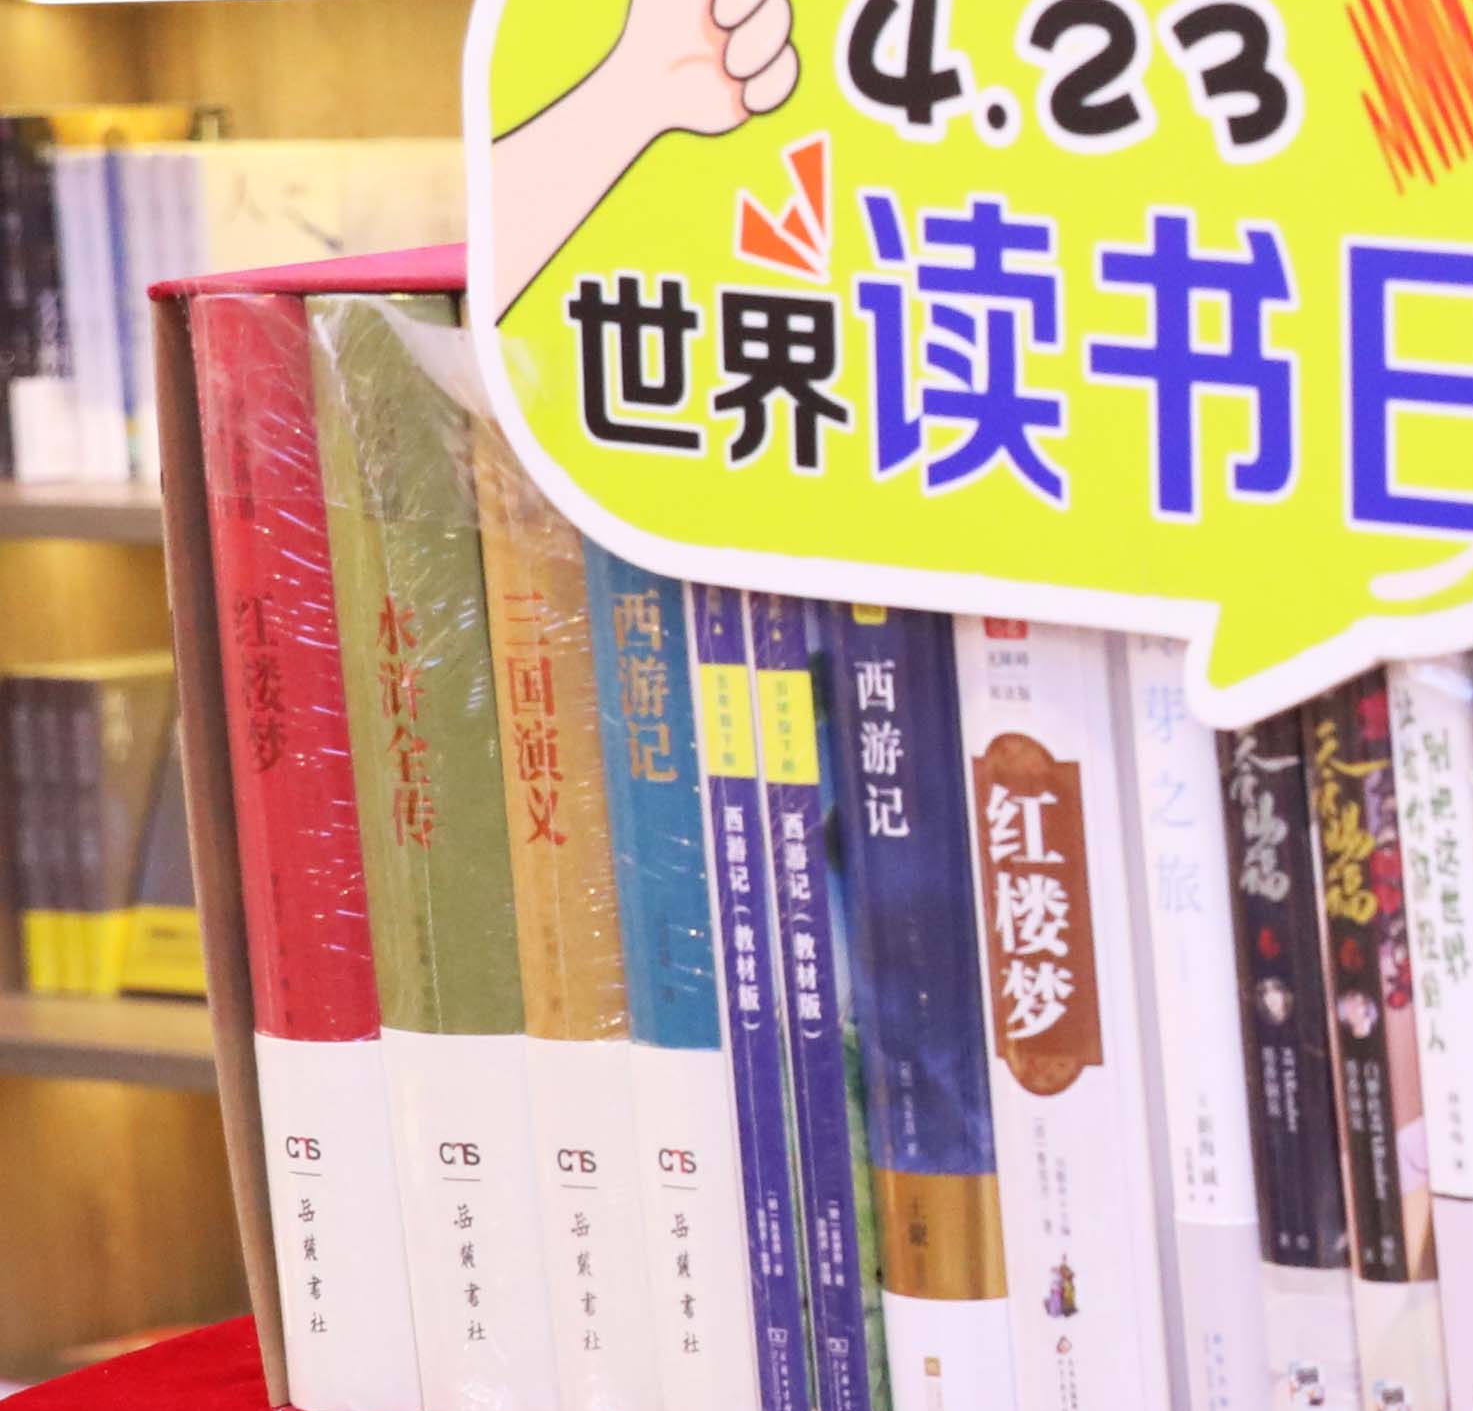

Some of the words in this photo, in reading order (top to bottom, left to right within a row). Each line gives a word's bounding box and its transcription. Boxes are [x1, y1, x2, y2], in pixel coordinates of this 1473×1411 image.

[376, 594, 438, 851] 水浒全传
[503, 591, 568, 848] 三国演义
[611, 590, 680, 784] 西游记
[856, 658, 912, 840] 西游记
[983, 782, 1075, 1040] 红楼梦
